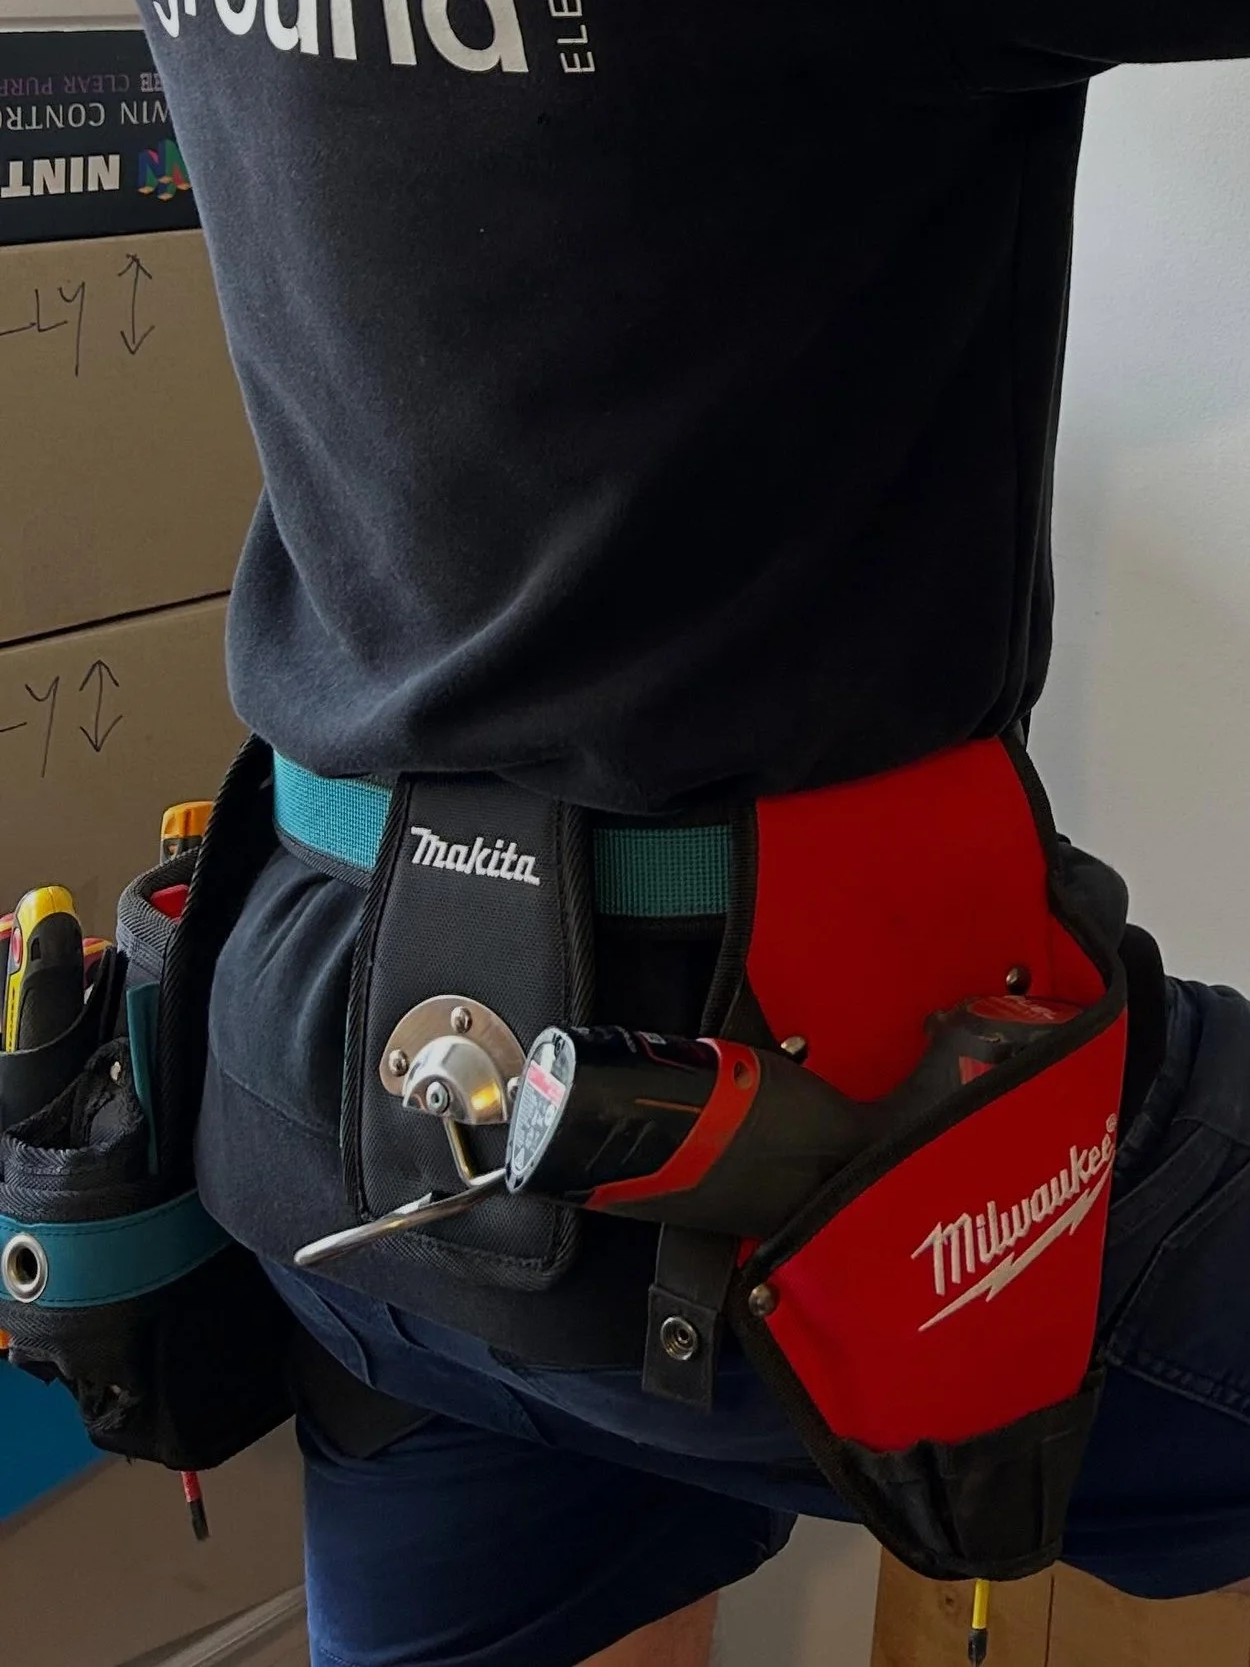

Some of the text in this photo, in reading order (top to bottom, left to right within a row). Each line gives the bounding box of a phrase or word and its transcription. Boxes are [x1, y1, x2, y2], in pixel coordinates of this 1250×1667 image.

[64, 73, 130, 95] CLEAR
[0, 102, 106, 131] CONTR
[1, 154, 121, 198] NINT
